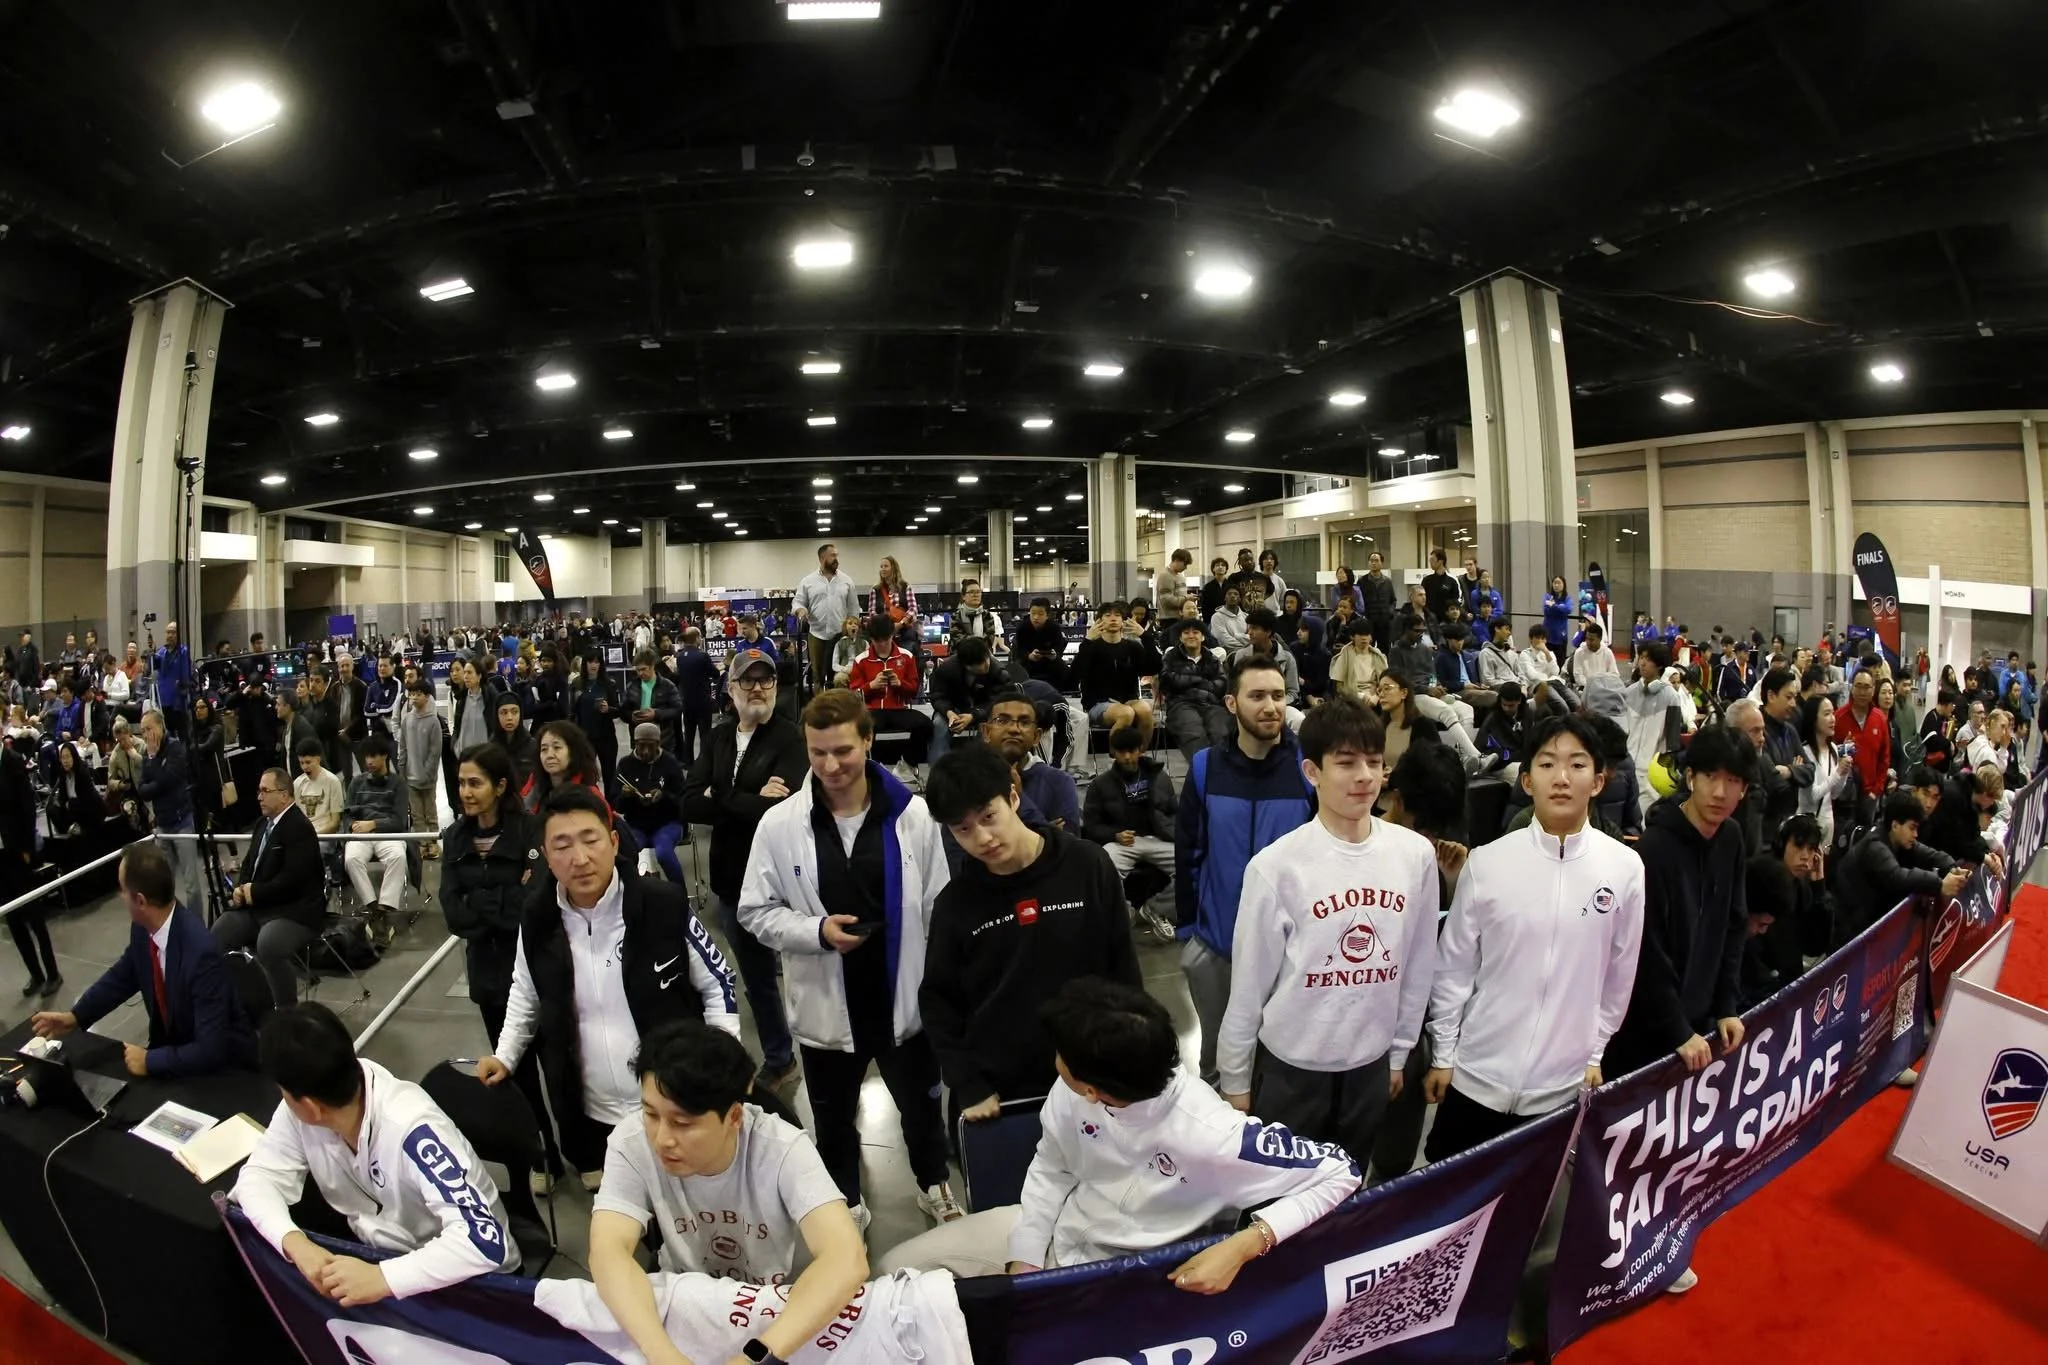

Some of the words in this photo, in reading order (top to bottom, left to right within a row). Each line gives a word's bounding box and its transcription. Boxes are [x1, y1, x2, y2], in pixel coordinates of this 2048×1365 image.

[1857, 550, 1883, 566] FINALS
[728, 640, 735, 648] IS
[1042, 901, 1084, 912] EXPLORING
[1312, 888, 1406, 919] GLOBUS
[1305, 965, 1399, 988] FENCING
[1602, 1060, 1726, 1187] THIS
[1729, 1027, 1774, 1109] IS
[1778, 1007, 1803, 1078] A
[1600, 1131, 1723, 1269] SAFE
[1724, 1041, 1843, 1169] SPACE
[1965, 1140, 2010, 1171] USA
[1579, 1298, 1611, 1316] who
[1616, 1262, 1666, 1304] compete,
[1586, 1283, 1612, 1299] We
